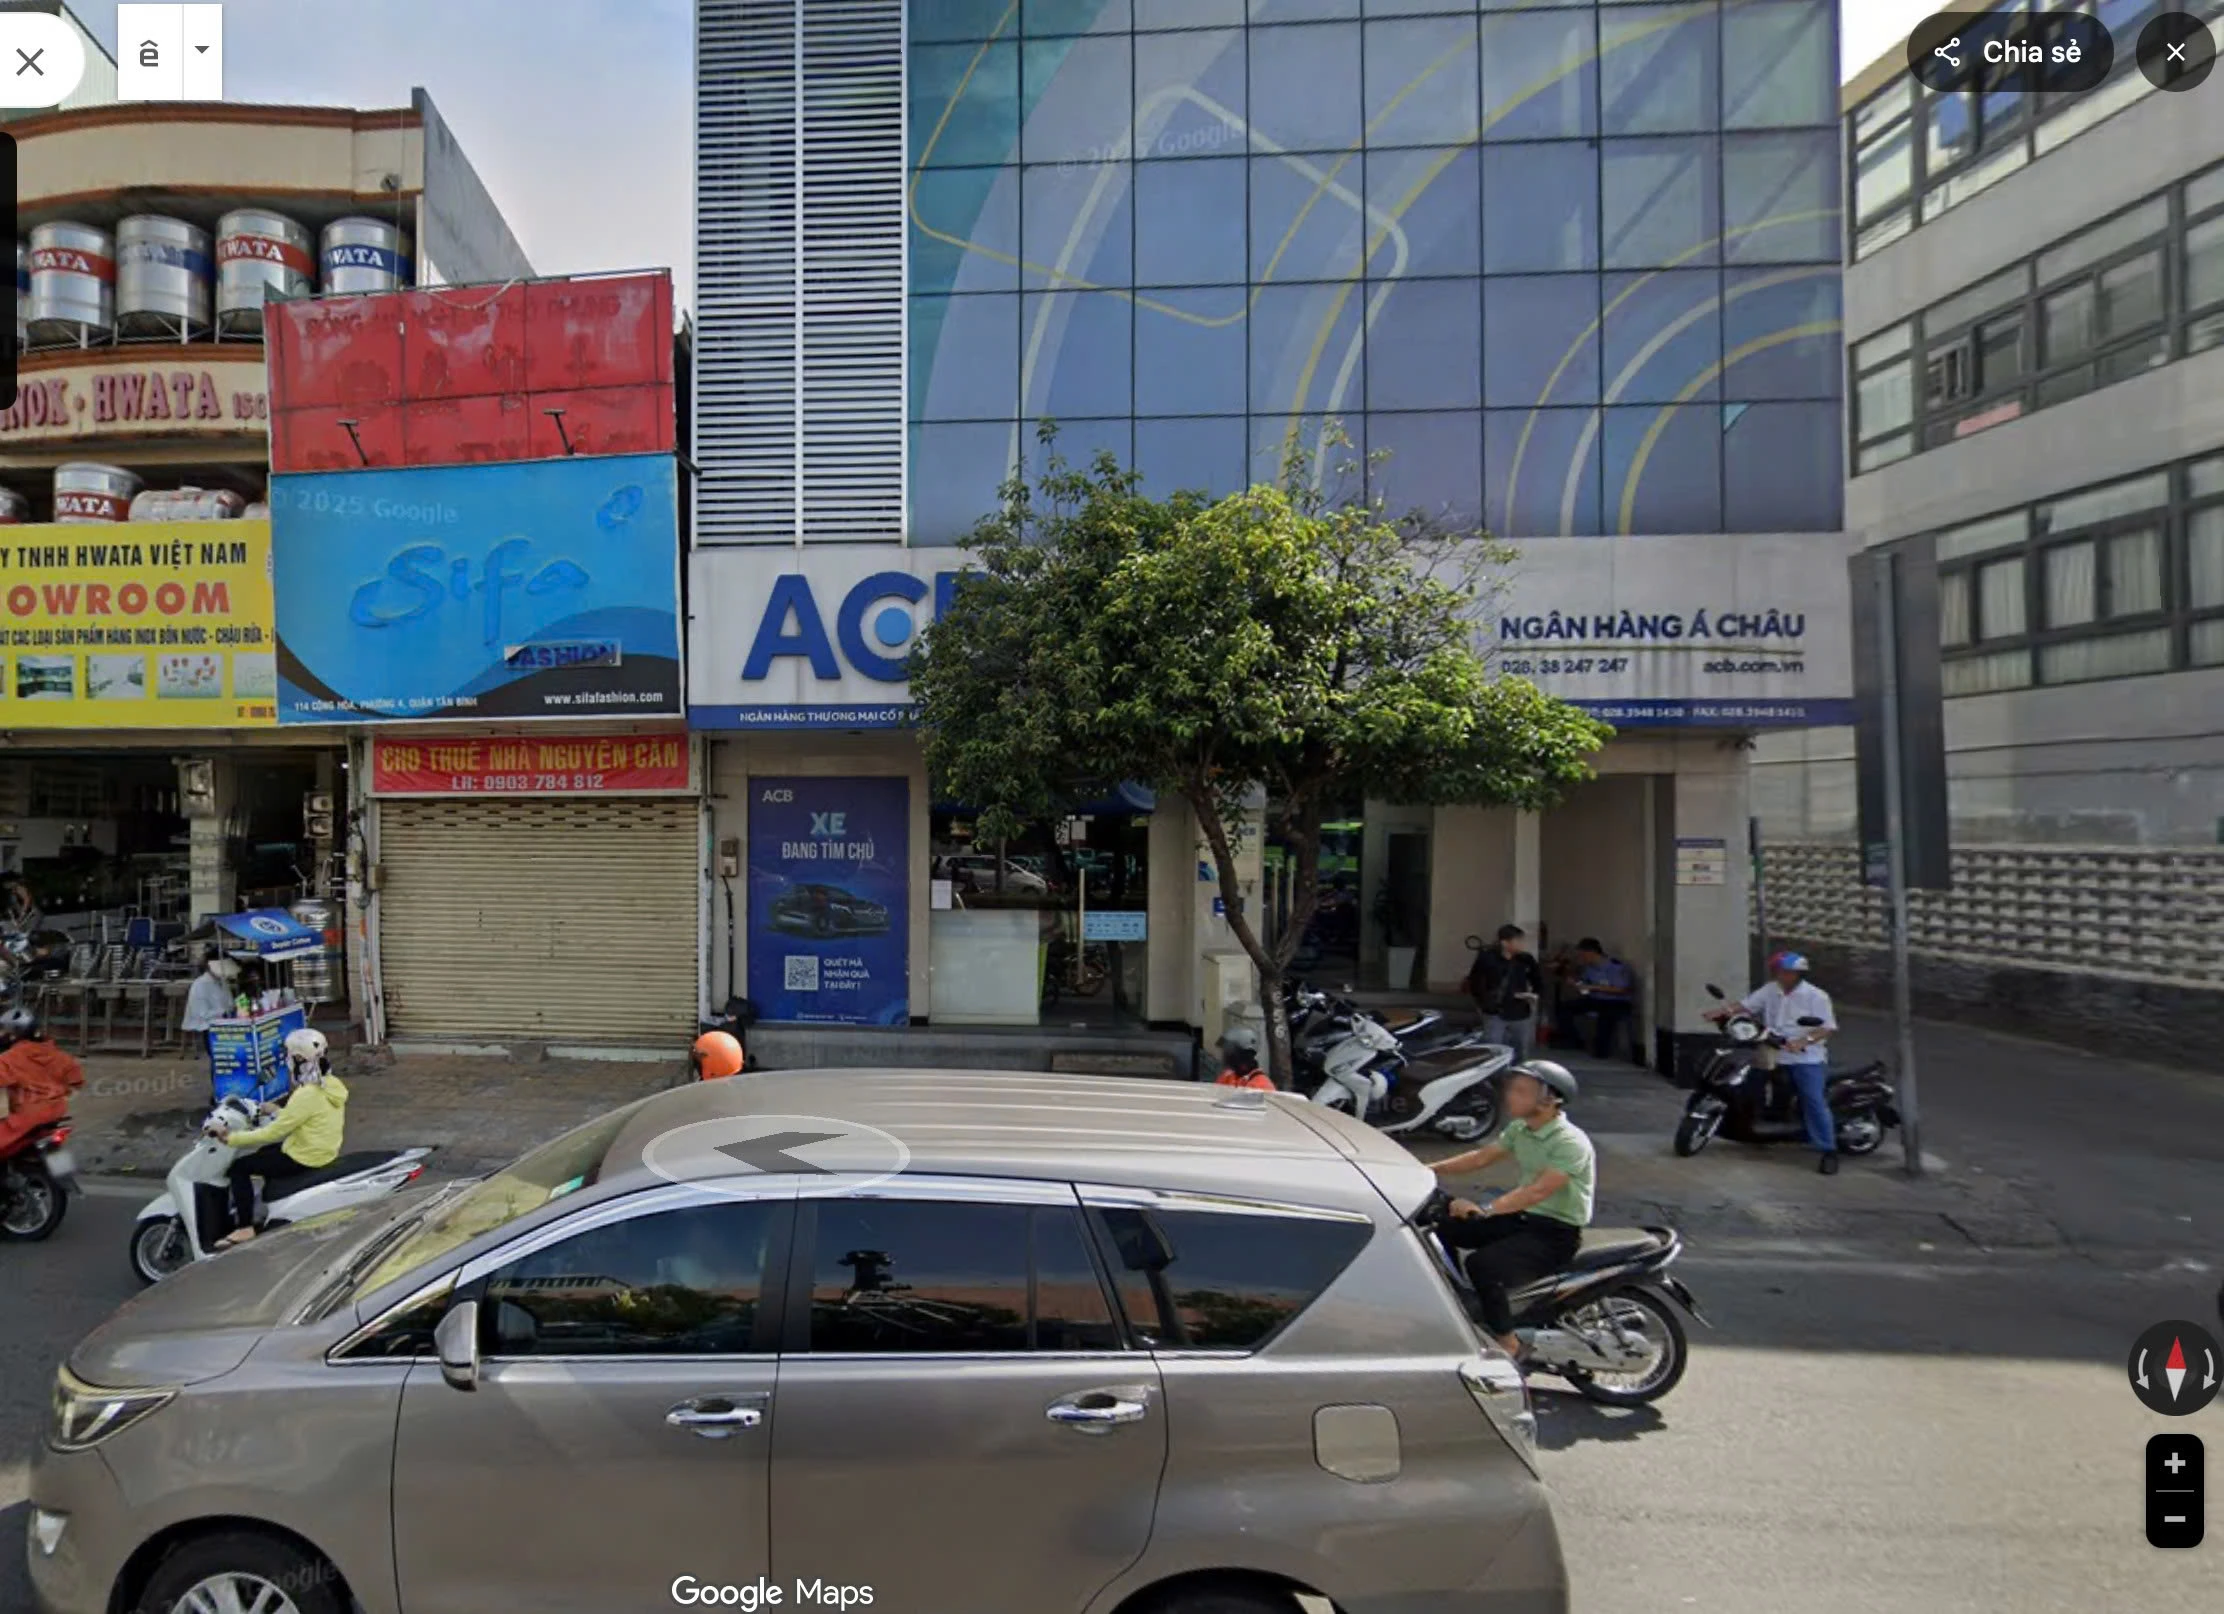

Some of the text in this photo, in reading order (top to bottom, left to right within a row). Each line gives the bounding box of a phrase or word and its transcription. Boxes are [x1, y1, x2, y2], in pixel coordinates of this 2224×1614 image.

[92, 371, 222, 422] HWATA
[17, 547, 70, 567] TNHH
[76, 545, 143, 567] HWATA
[150, 539, 193, 571] VIỆT
[201, 542, 247, 566] NAM
[7, 582, 231, 616] OWROOM
[741, 571, 988, 682] AC
[1501, 608, 1805, 640] NGÂN HÀNG Á CHÂU
[1564, 658, 1594, 674] 247
[1598, 657, 1629, 674] 247
[740, 710, 772, 722] NGÂN
[773, 710, 806, 722] HÀNG
[807, 711, 857, 722] THƯƠNG
[858, 711, 877, 724] MẠI
[382, 745, 420, 773] CHO
[430, 741, 480, 772] THUÊ
[490, 740, 531, 771] NHÀ
[539, 739, 628, 770] NGUYÊN
[452, 775, 478, 791] LH:
[535, 774, 568, 790] 784
[573, 772, 604, 789] 812
[762, 789, 793, 803] ACB
[810, 812, 847, 835] XE
[782, 837, 874, 859] ĐANG TÌM CHỦ
